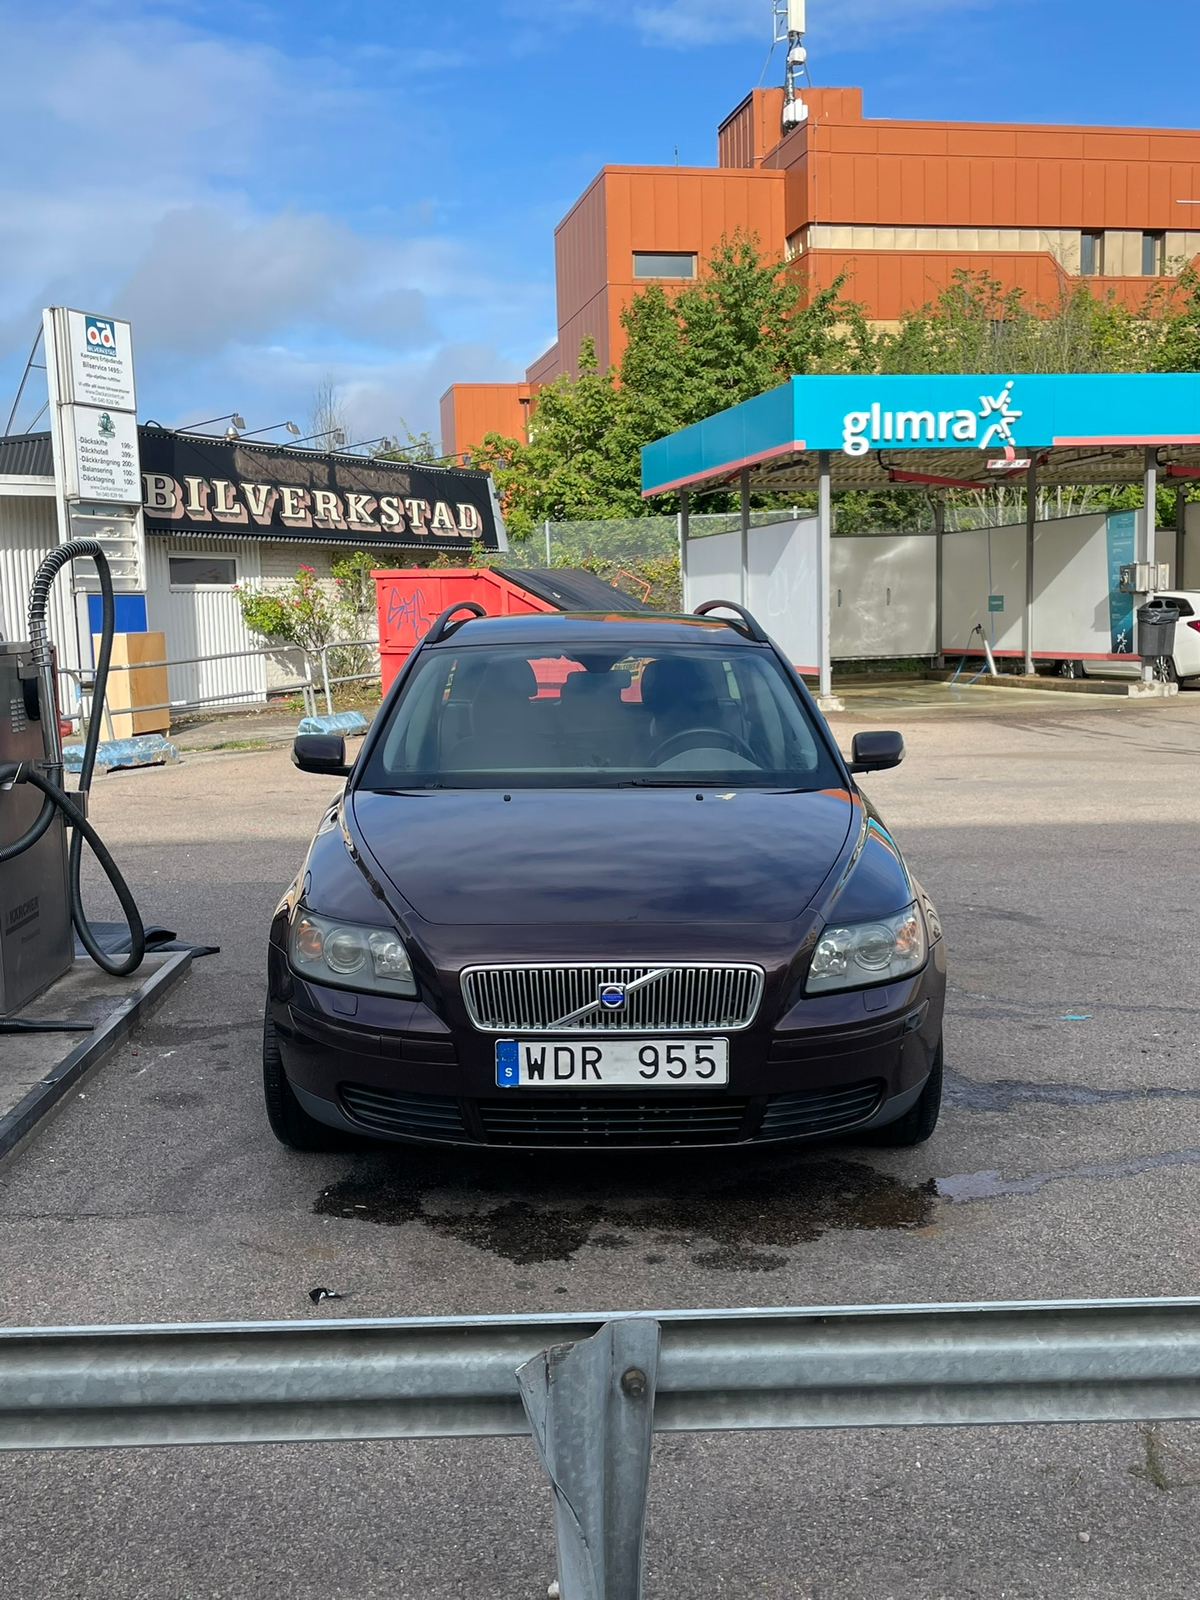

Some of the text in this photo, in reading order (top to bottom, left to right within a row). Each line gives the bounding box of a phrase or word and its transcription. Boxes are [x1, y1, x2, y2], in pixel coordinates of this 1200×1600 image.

[82, 361, 107, 372] Bilservice
[842, 402, 977, 456] glimra
[142, 472, 482, 537] BILVERKSTAD
[504, 1068, 513, 1077] S
[525, 1044, 716, 1080] WDR 955
